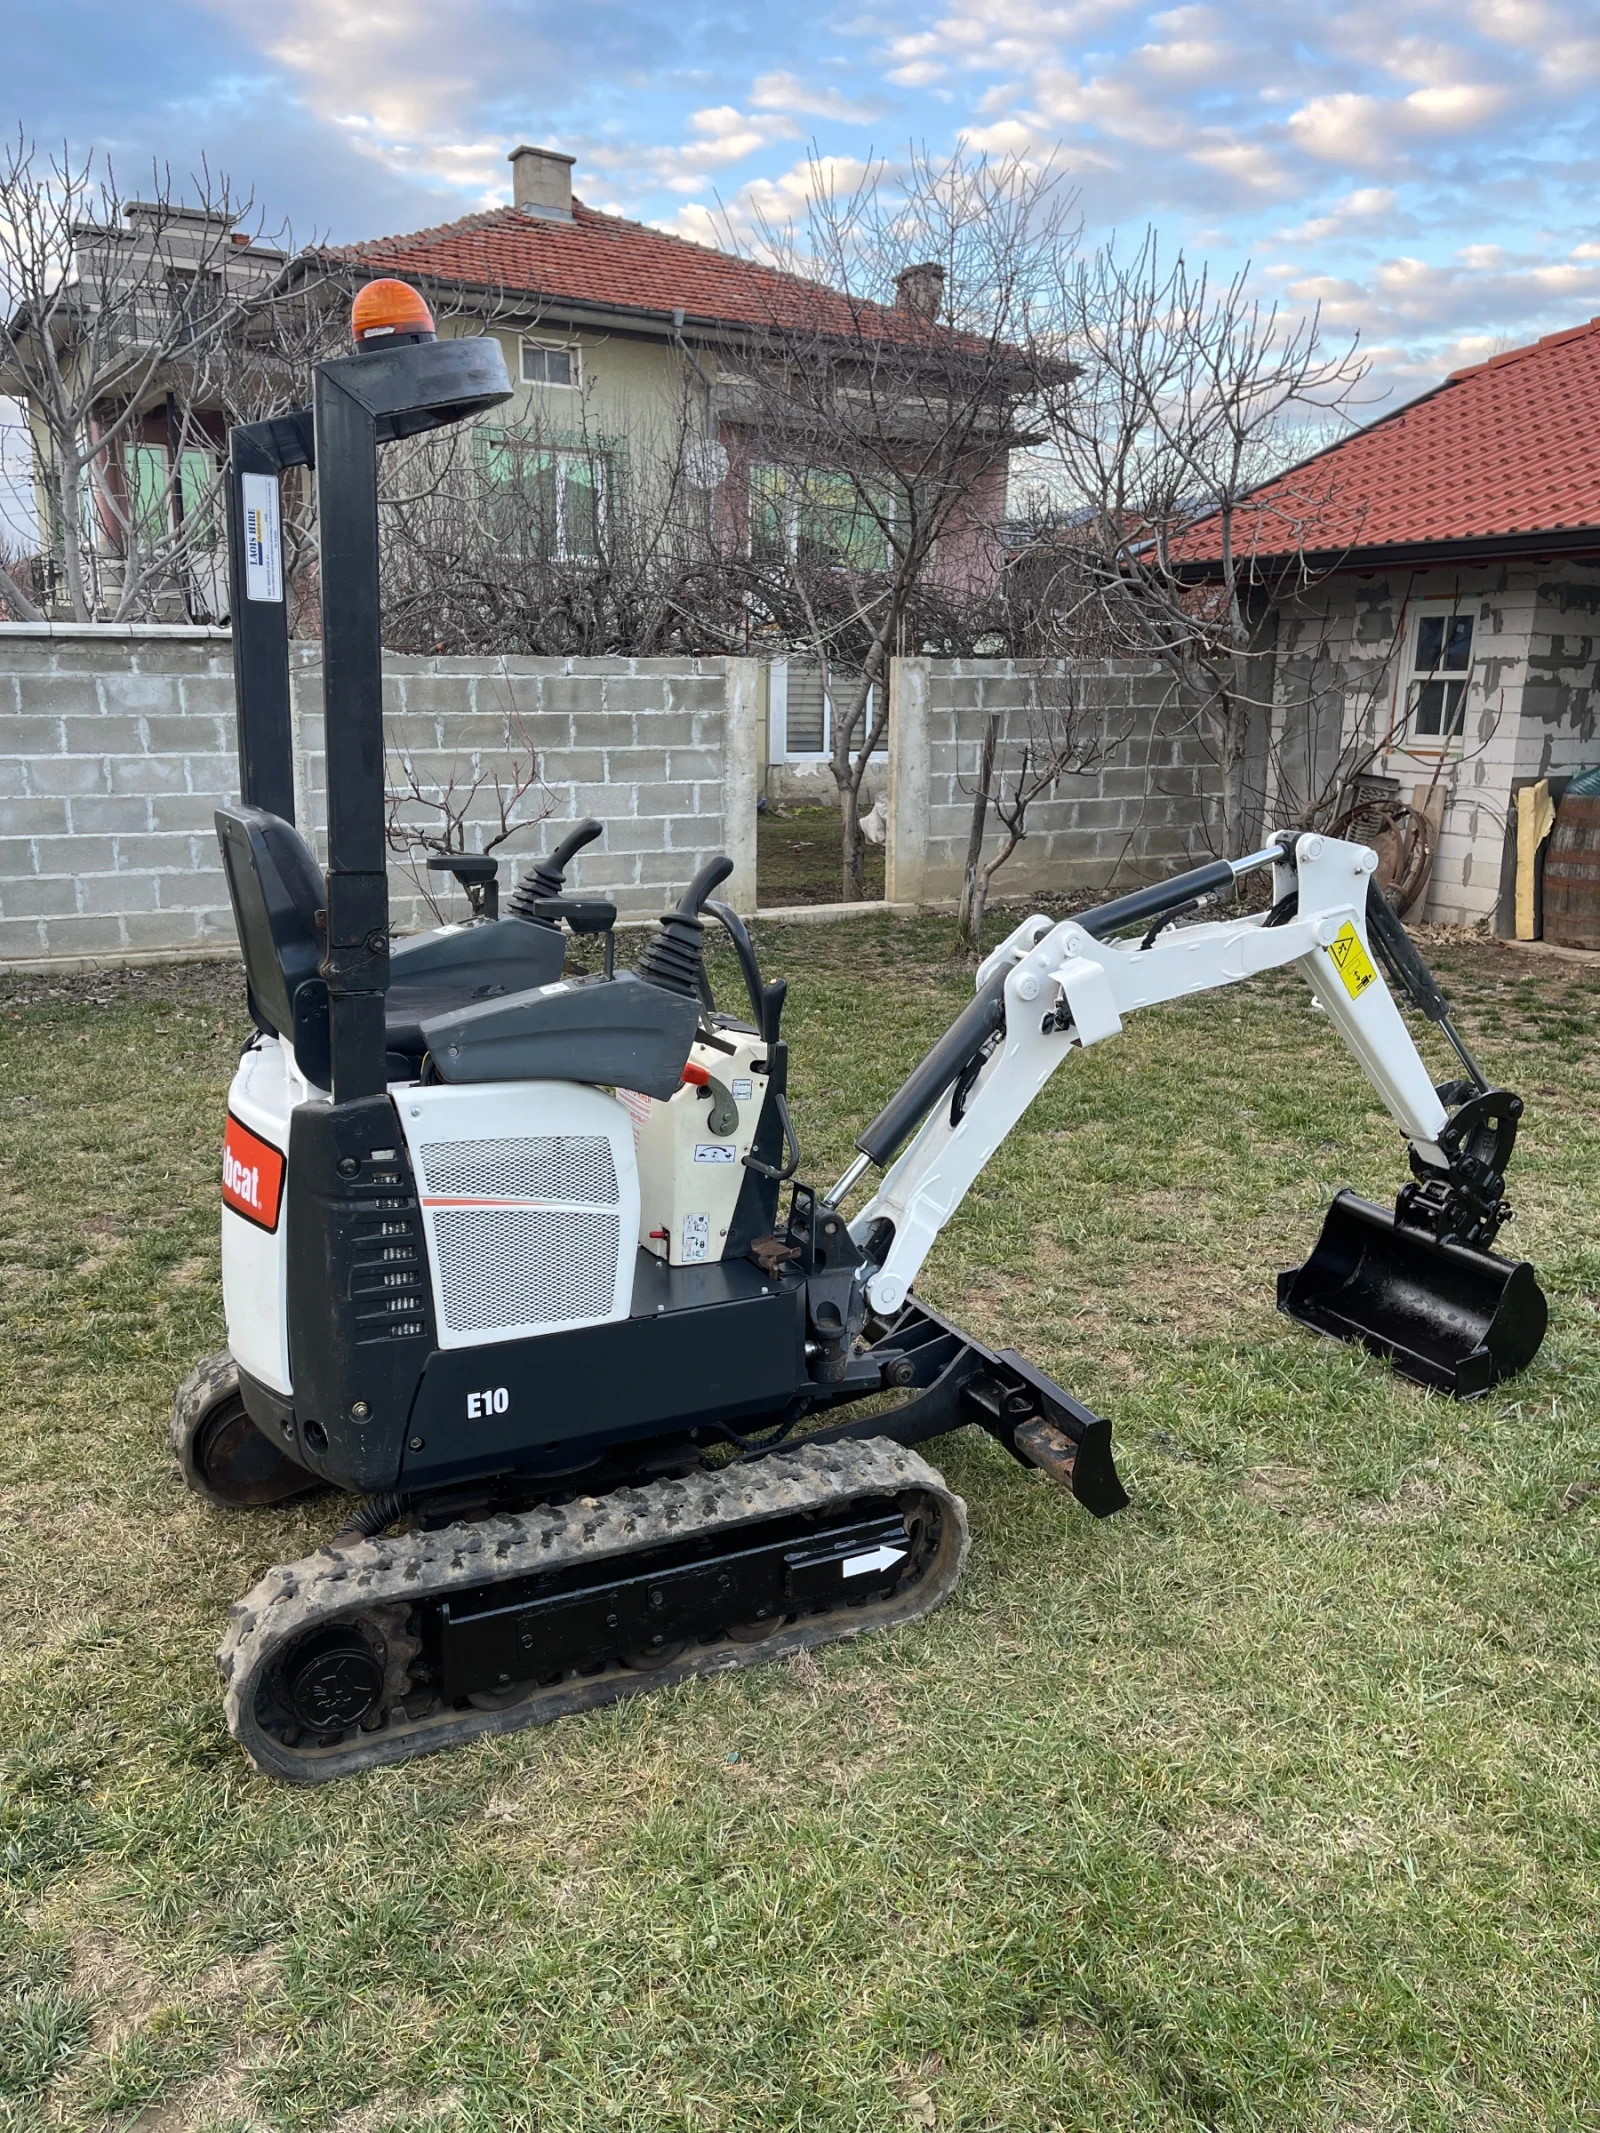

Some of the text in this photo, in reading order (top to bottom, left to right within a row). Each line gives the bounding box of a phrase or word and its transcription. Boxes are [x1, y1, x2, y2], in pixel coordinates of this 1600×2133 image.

[247, 508, 258, 566] LAOIS HIRE
[223, 1145, 258, 1208] bcat
[467, 1387, 509, 1419] E10
